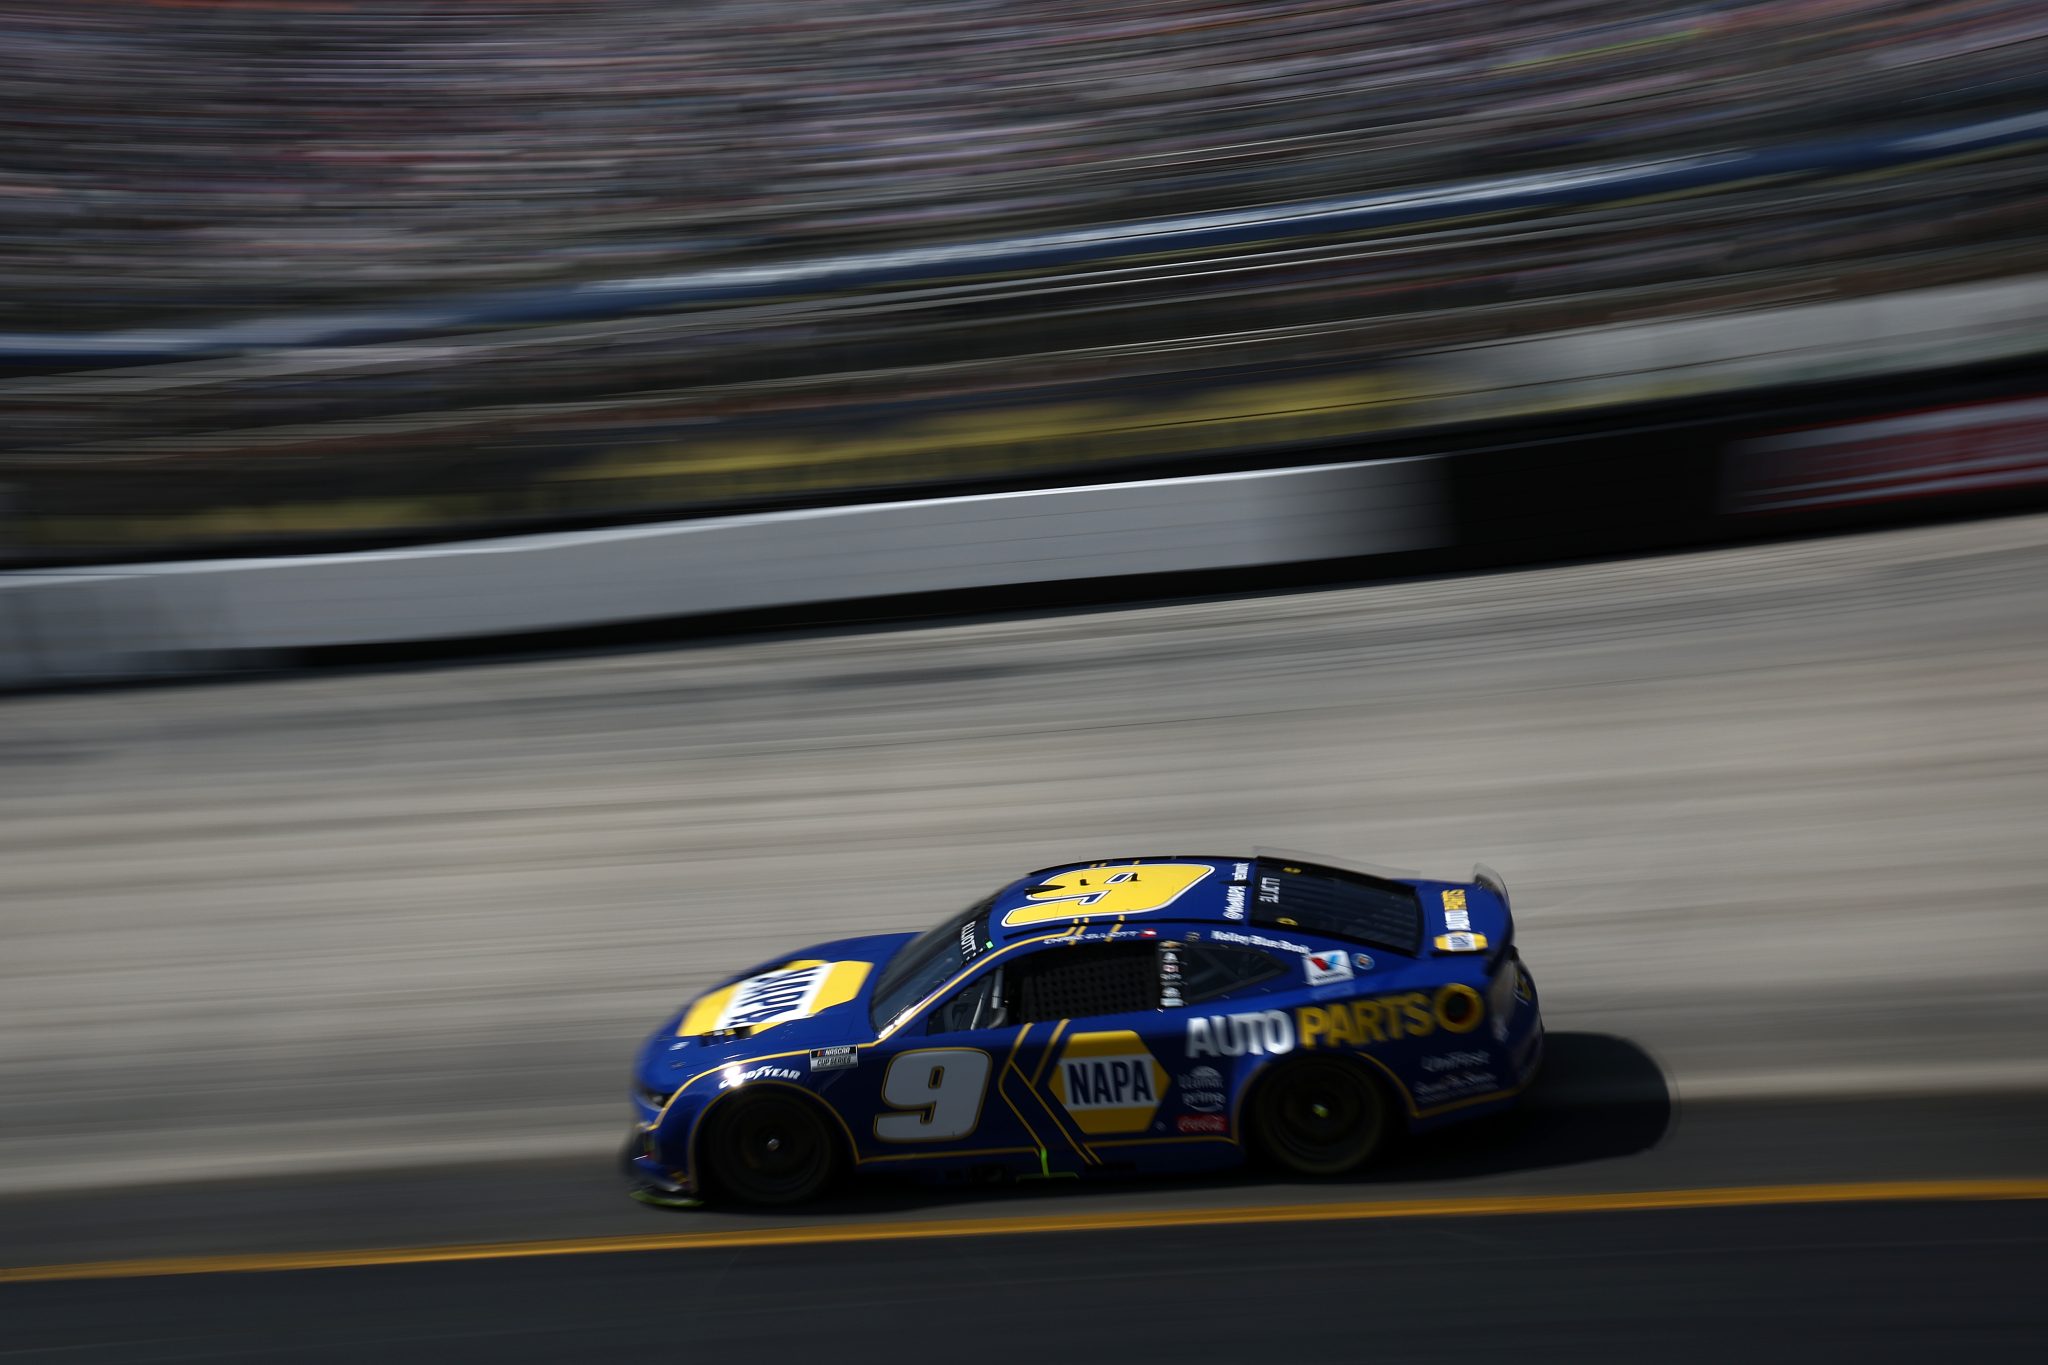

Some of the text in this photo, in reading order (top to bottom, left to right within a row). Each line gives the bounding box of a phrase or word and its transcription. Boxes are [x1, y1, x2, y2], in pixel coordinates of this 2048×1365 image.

[1001, 863, 1215, 928] 9
[1186, 992, 1437, 1058] AUTO PARTS
[718, 1065, 801, 1090] GODYEAR
[874, 1047, 993, 1144] 9
[1067, 1060, 1153, 1106] NAPA
